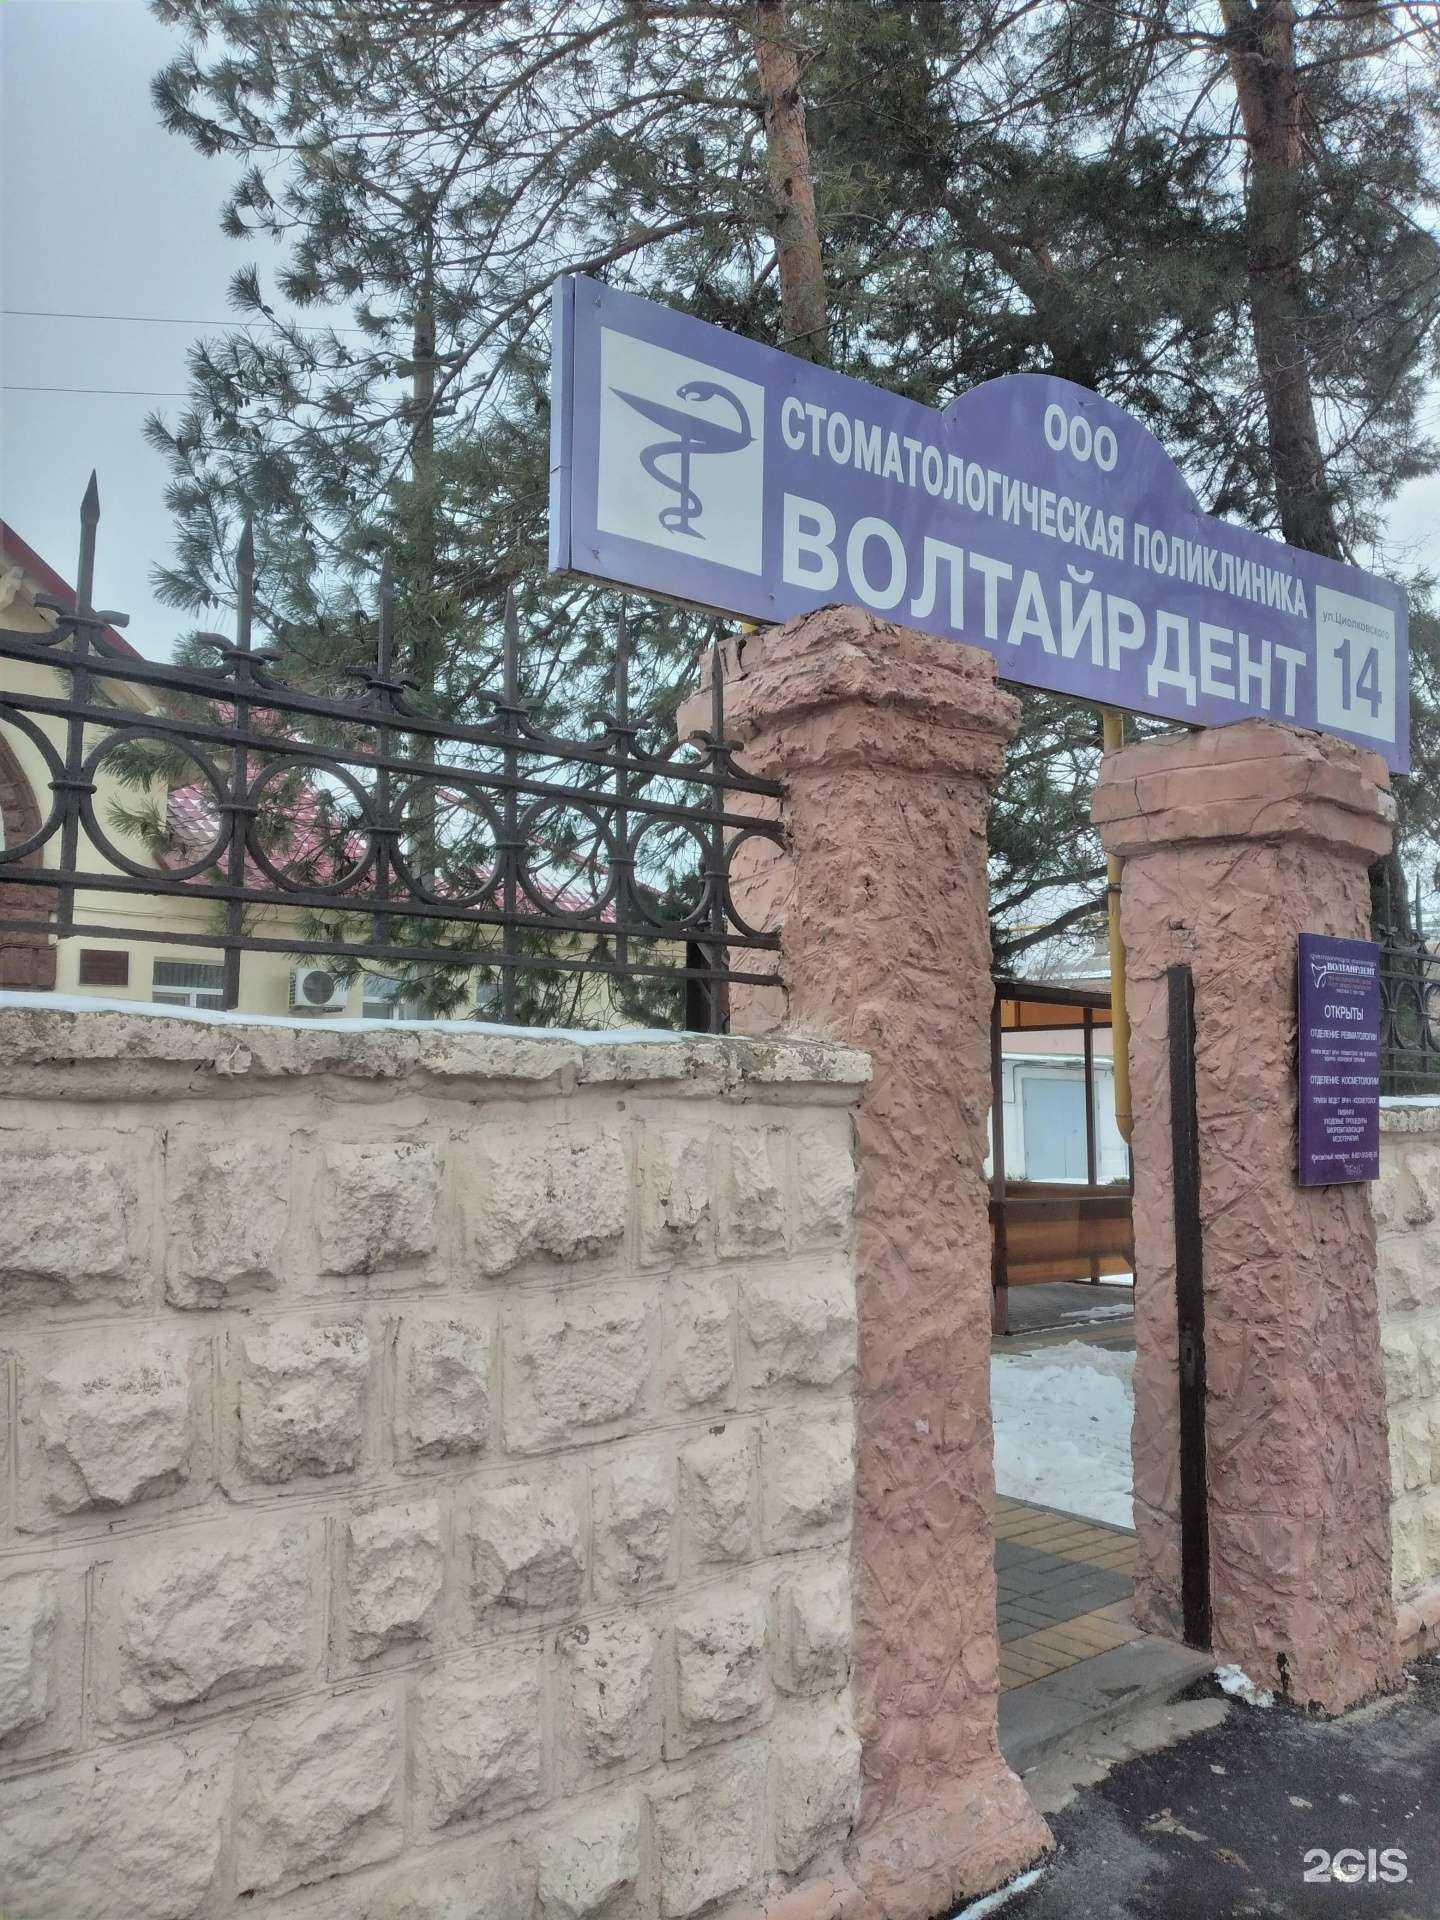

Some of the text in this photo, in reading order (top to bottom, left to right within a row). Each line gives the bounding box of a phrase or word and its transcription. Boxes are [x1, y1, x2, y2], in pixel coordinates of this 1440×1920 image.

[1044, 404, 1118, 472] ООО
[781, 396, 1308, 619] СТОМАТОЛОГИЧЕСКАЯ ПОЛИКЛИНИКА
[783, 492, 1307, 717] ВОЛТАЙРДЕНТ
[1333, 638, 1383, 718] 14
[1324, 1005, 1364, 1021] ОТКРЫТЫ
